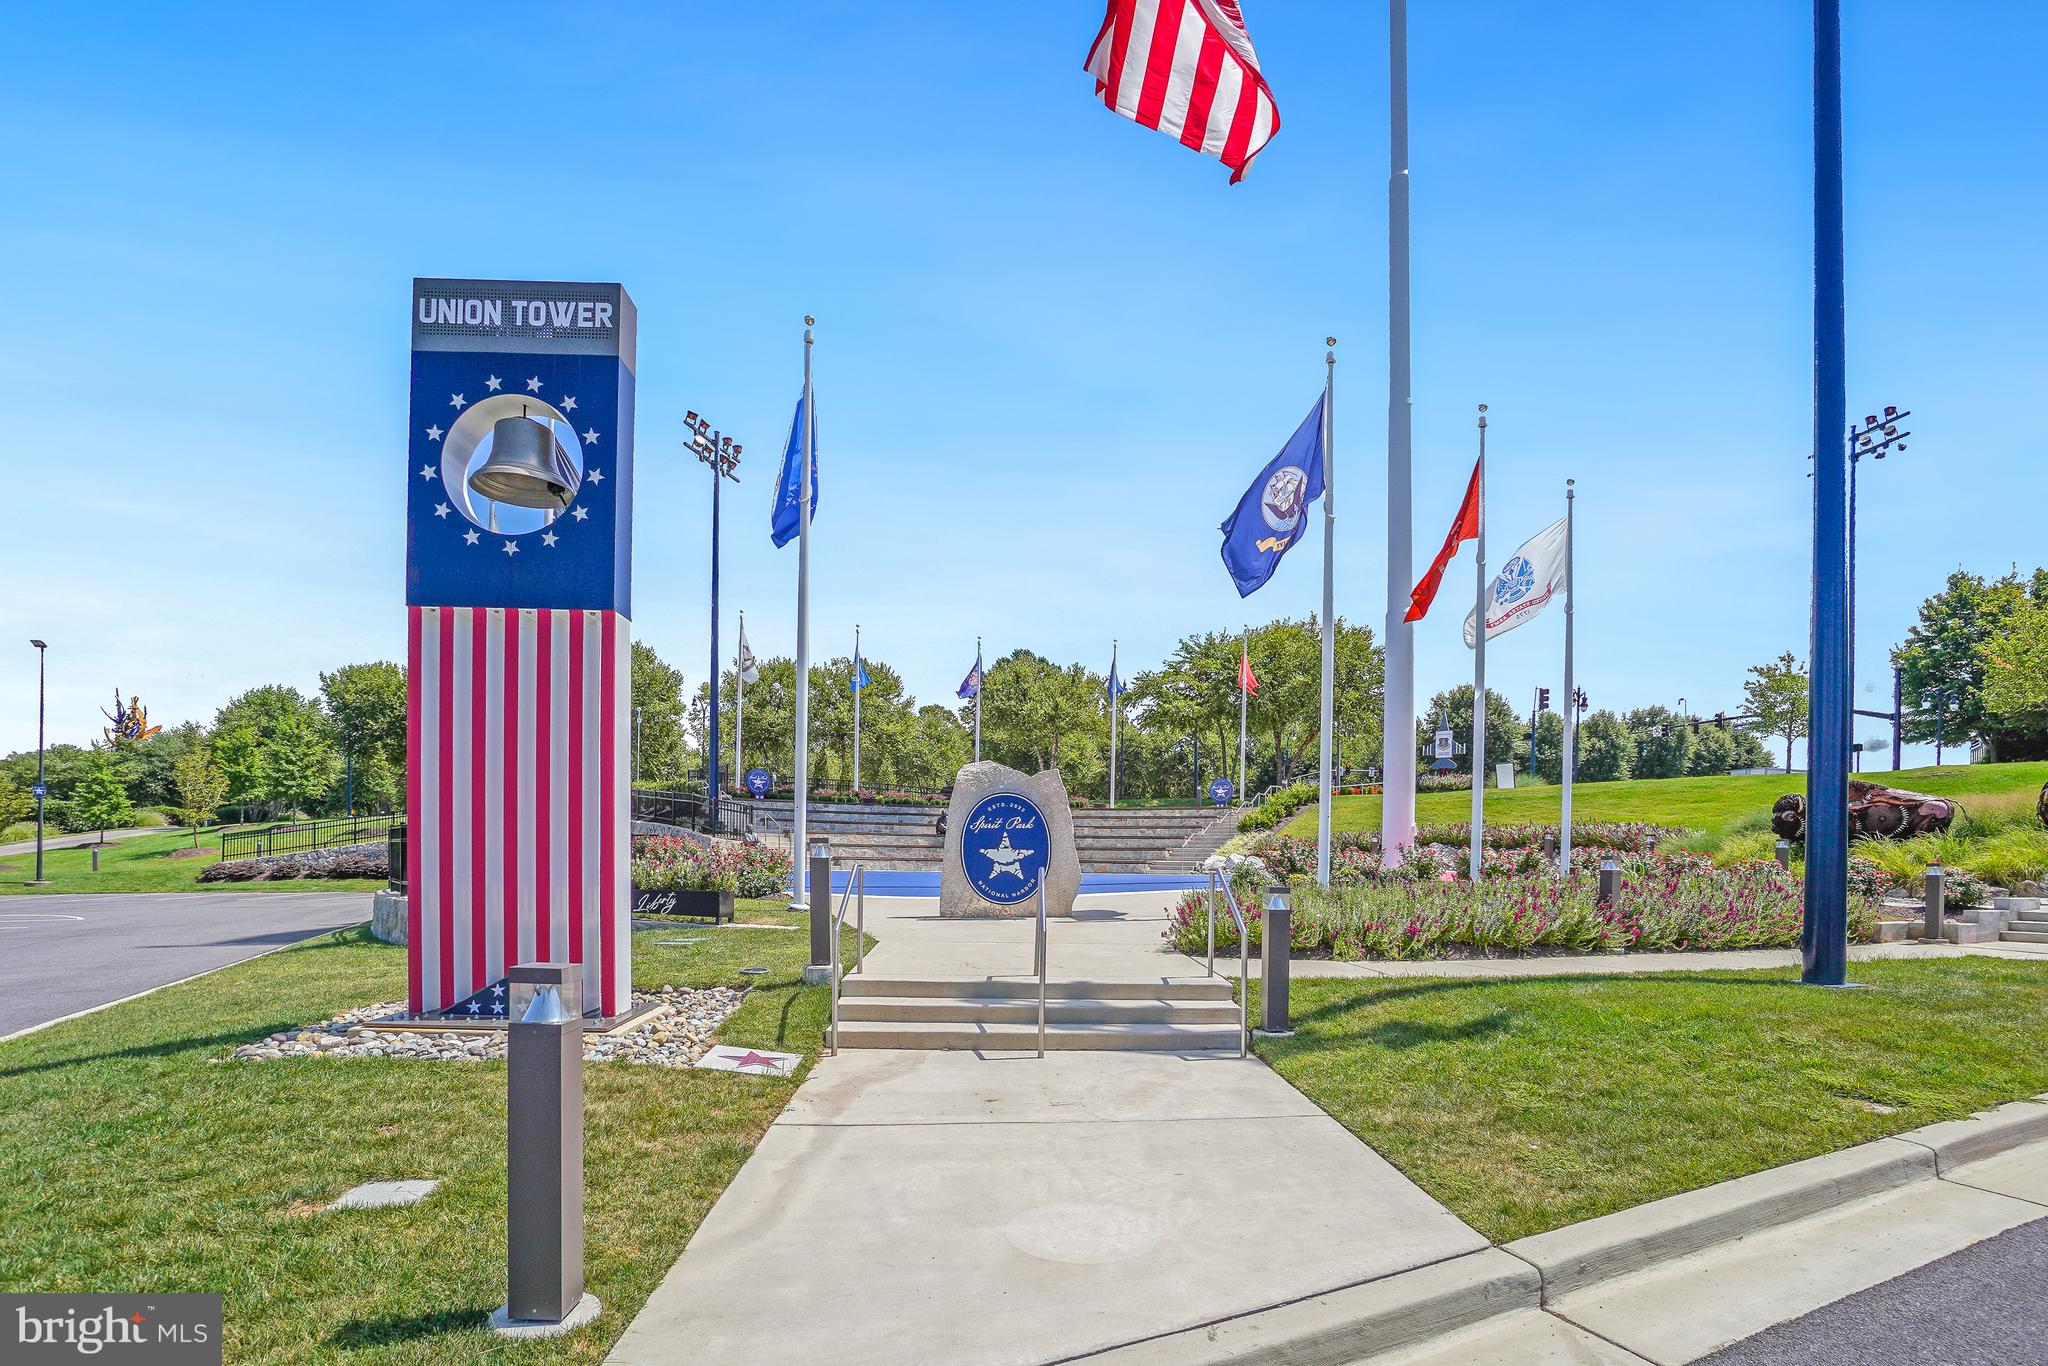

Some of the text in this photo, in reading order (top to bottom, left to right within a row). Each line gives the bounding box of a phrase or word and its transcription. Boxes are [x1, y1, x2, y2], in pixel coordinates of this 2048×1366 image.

[418, 298, 613, 328] UNION TOWER
[969, 814, 1036, 834] Spirit Park
[977, 878, 1036, 899] NATIONAL HARBOR
[633, 891, 678, 915] Liberty
